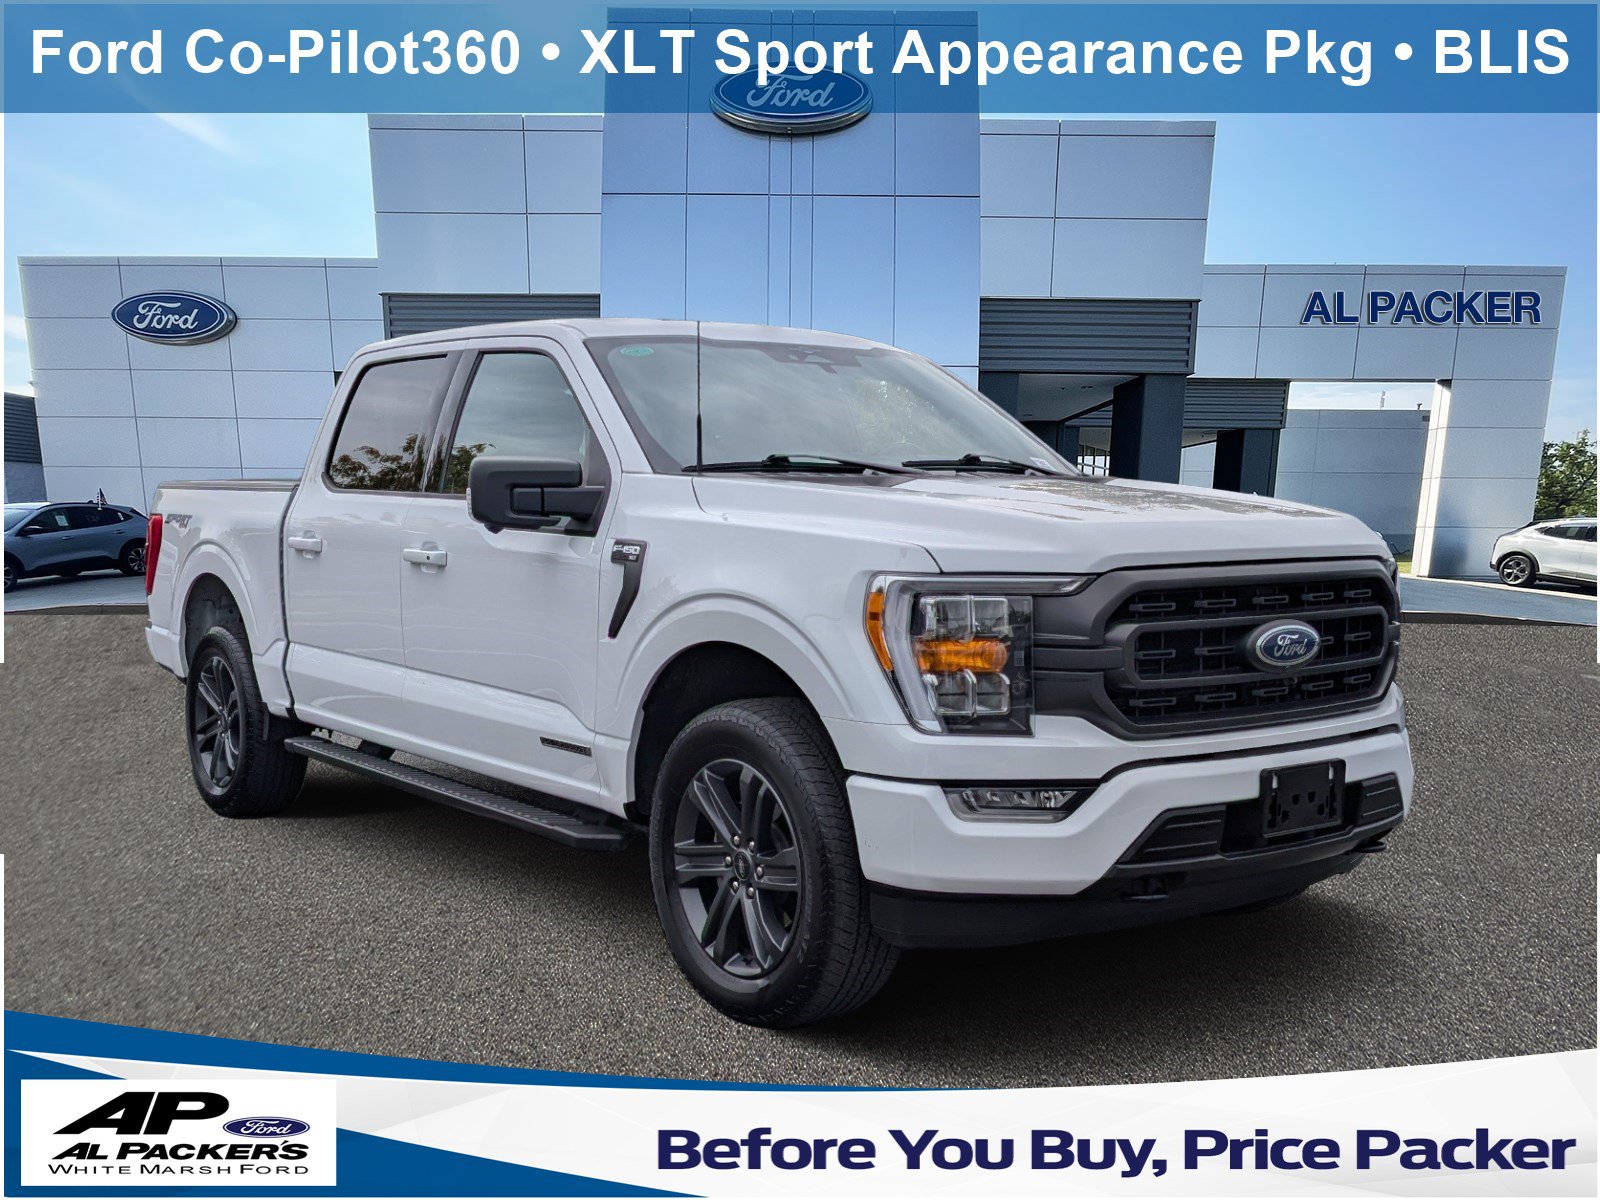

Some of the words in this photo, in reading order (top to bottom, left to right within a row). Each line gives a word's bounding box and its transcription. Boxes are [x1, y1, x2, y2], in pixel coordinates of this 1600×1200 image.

[746, 73, 836, 108] Ford
[132, 301, 199, 329] Ford
[1302, 290, 1359, 324] AL
[1369, 290, 1542, 325] PACKER
[1273, 634, 1308, 657] Ford
